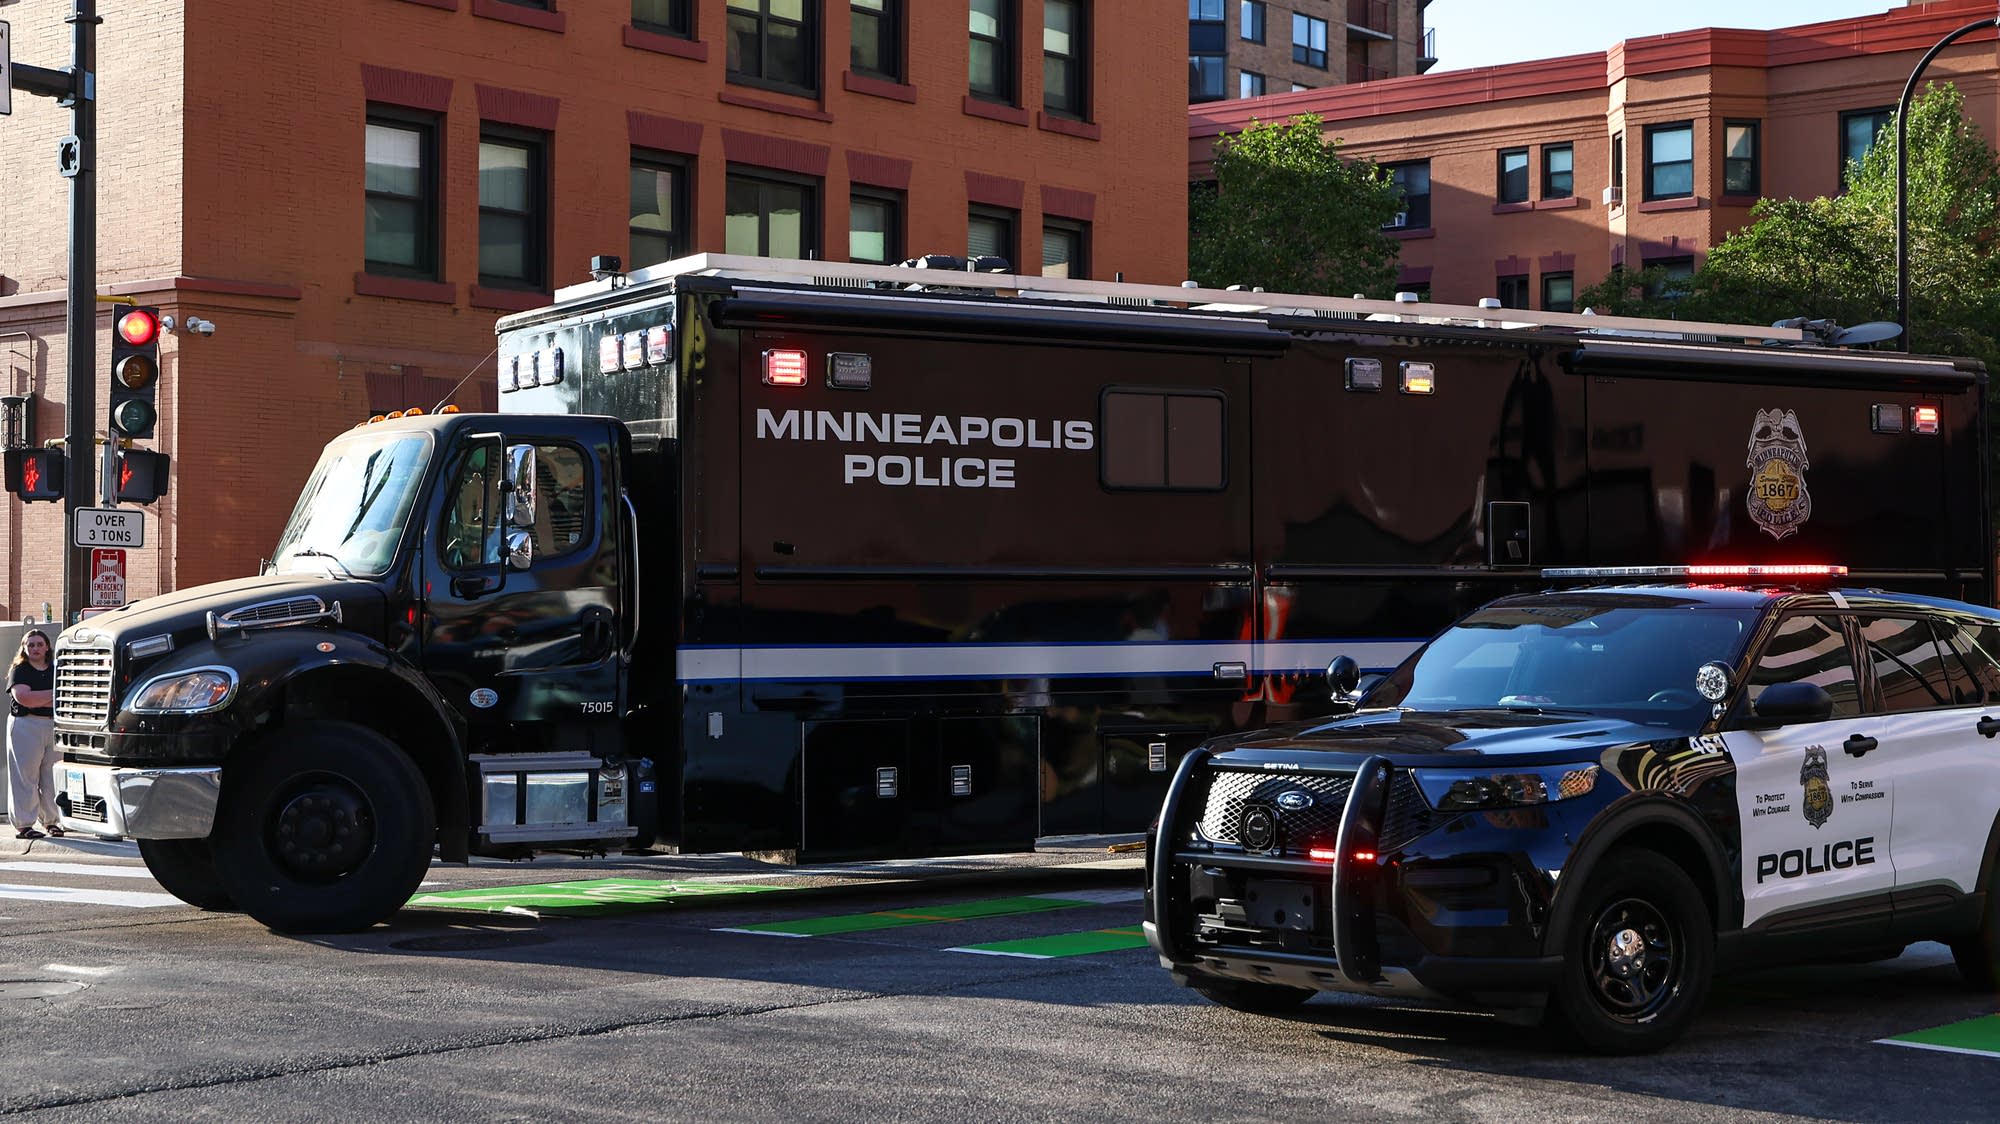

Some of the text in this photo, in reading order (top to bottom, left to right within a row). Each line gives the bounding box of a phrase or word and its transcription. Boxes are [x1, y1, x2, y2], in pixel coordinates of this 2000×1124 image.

[756, 408, 1094, 450] MINNEAPOLIS
[844, 454, 1016, 489] POLICE
[1762, 483, 1794, 497] 1867
[95, 514, 125, 527] OVER
[1760, 508, 1798, 524] POLICE
[88, 529, 131, 542] 3 TONS
[100, 574, 117, 583] SNOW
[94, 583, 123, 591] EMERGENCY
[100, 591, 118, 600] ROUTE
[580, 701, 614, 713] 75015
[1263, 762, 1299, 770] SETINA
[1283, 794, 1304, 806] Ford
[1757, 836, 1876, 884] POLICE
